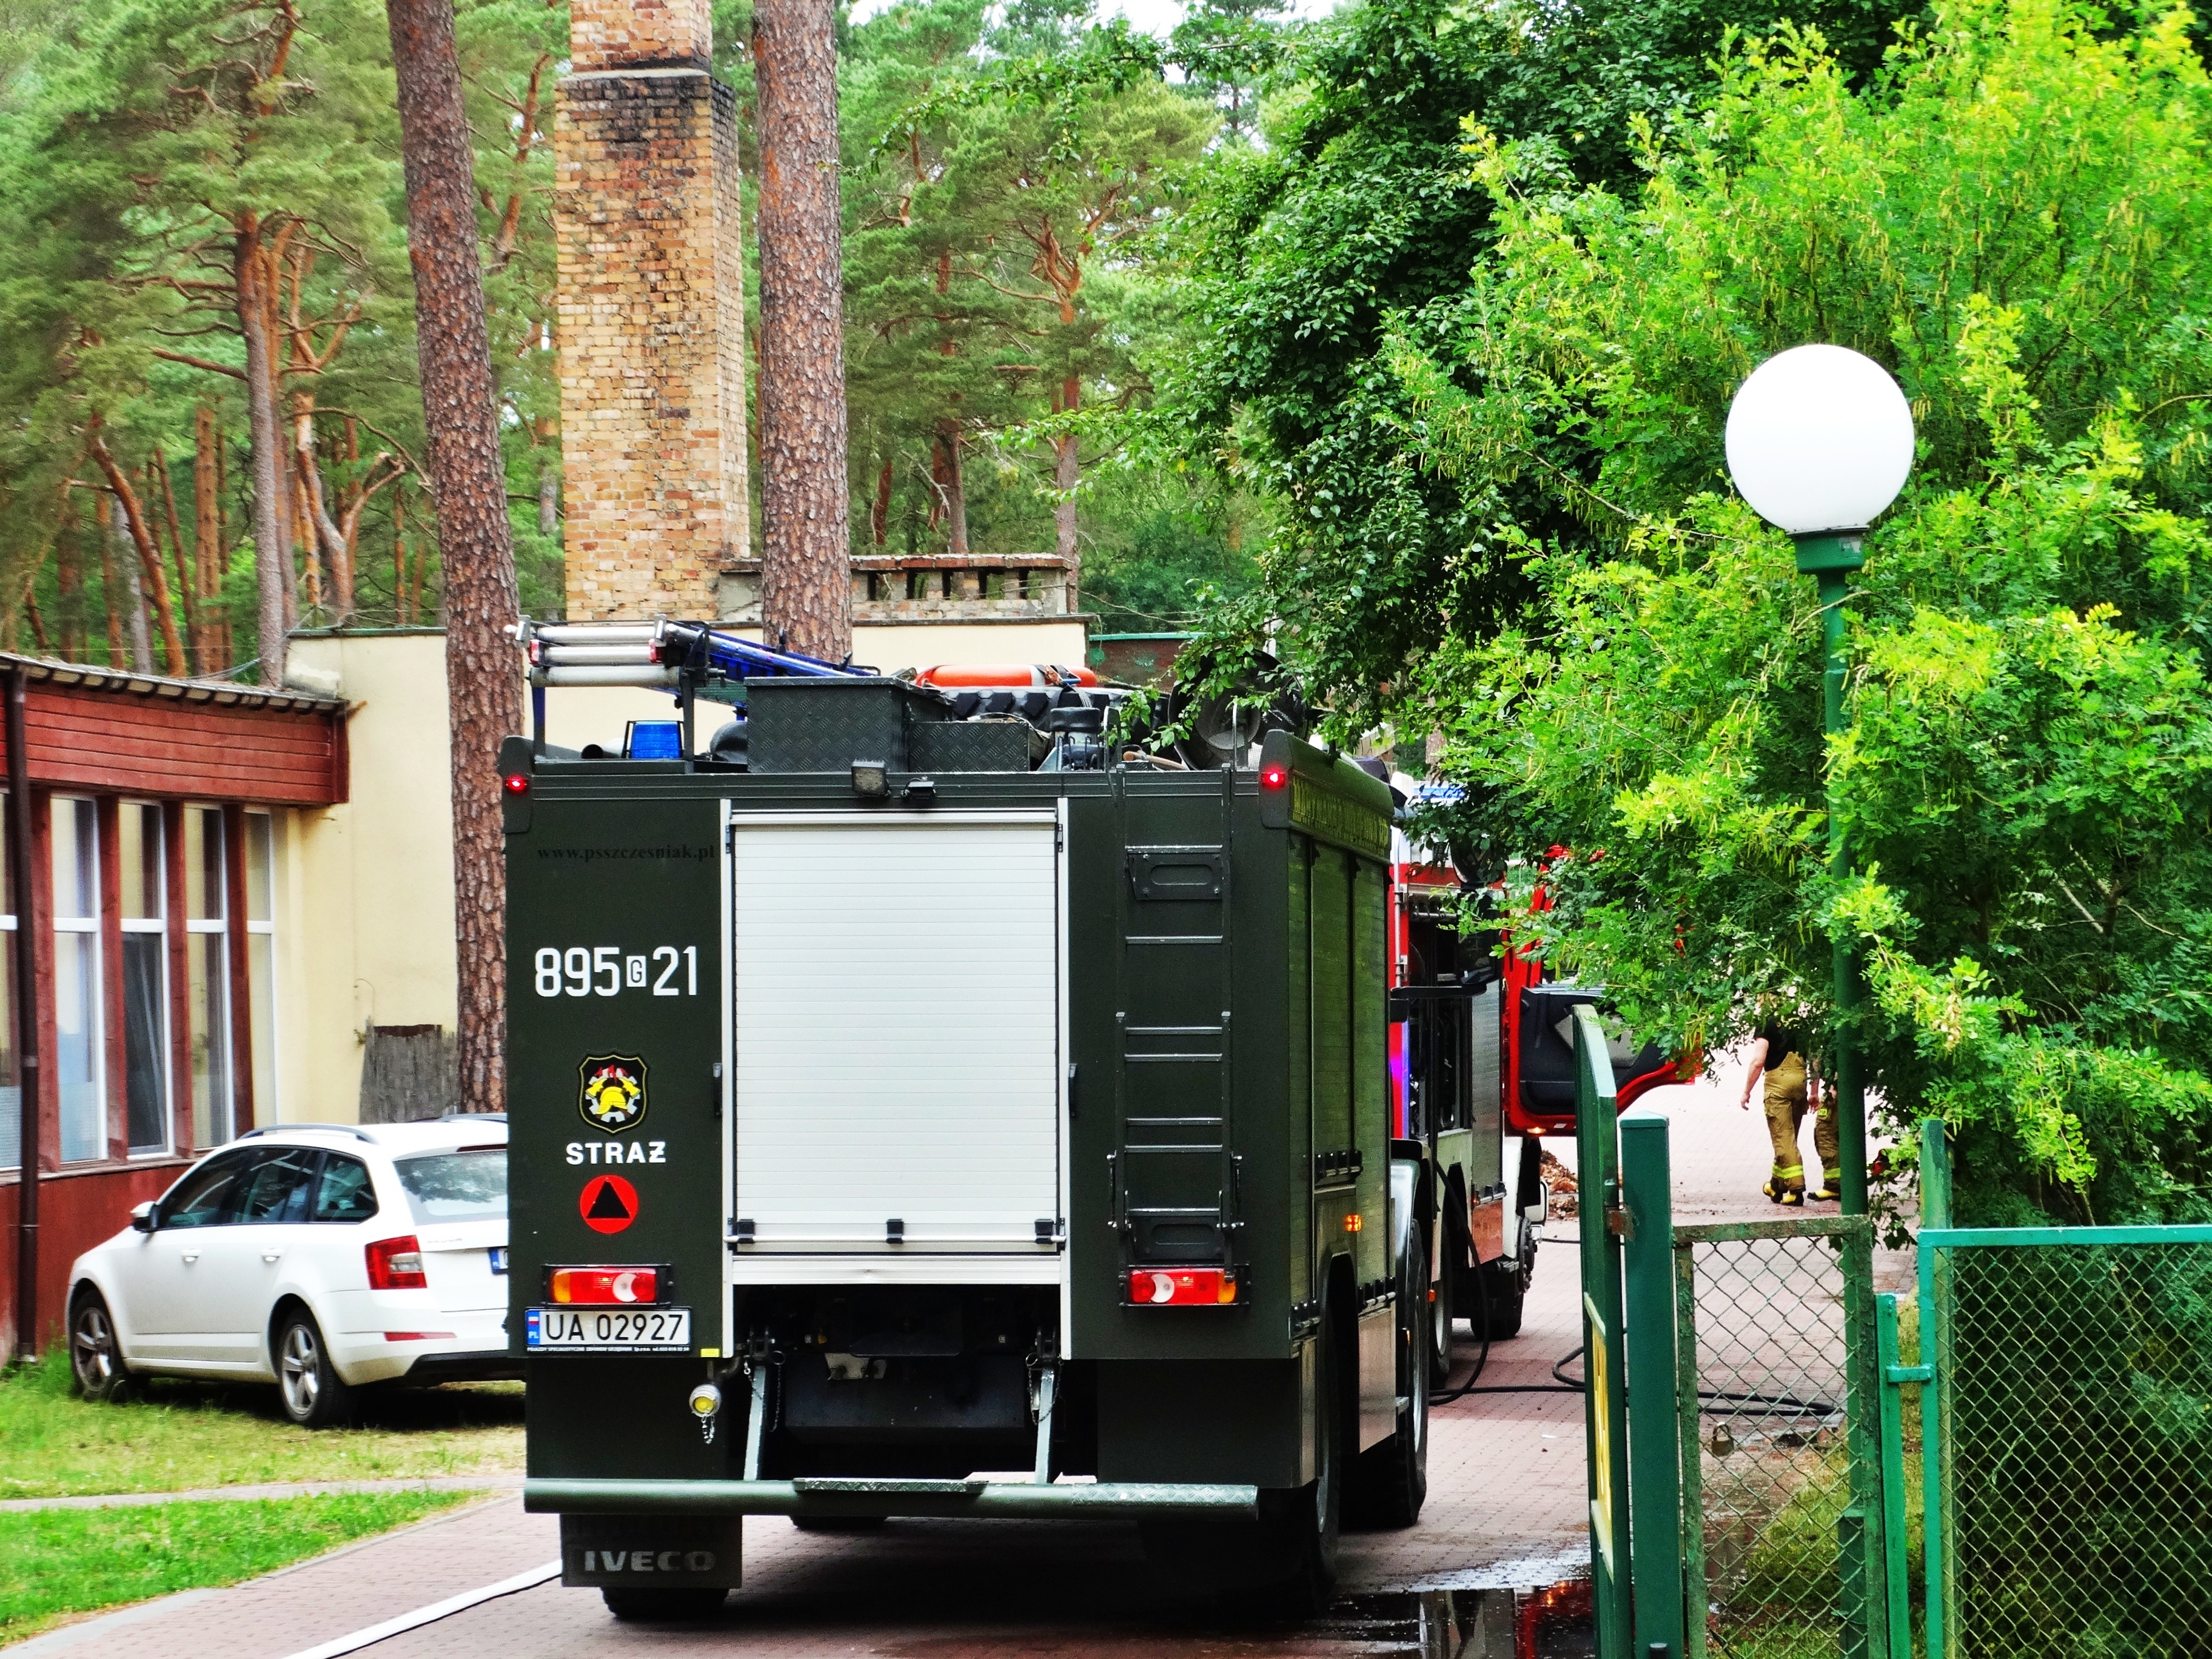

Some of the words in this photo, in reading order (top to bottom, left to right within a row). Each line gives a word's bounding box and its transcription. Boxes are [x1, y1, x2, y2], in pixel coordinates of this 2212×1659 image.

[535, 947, 620, 997] 895
[631, 959, 642, 984] G
[652, 945, 697, 996] 21
[546, 1313, 585, 1341] UA
[597, 1313, 683, 1341] 02927
[584, 1550, 716, 1572] IVECO
